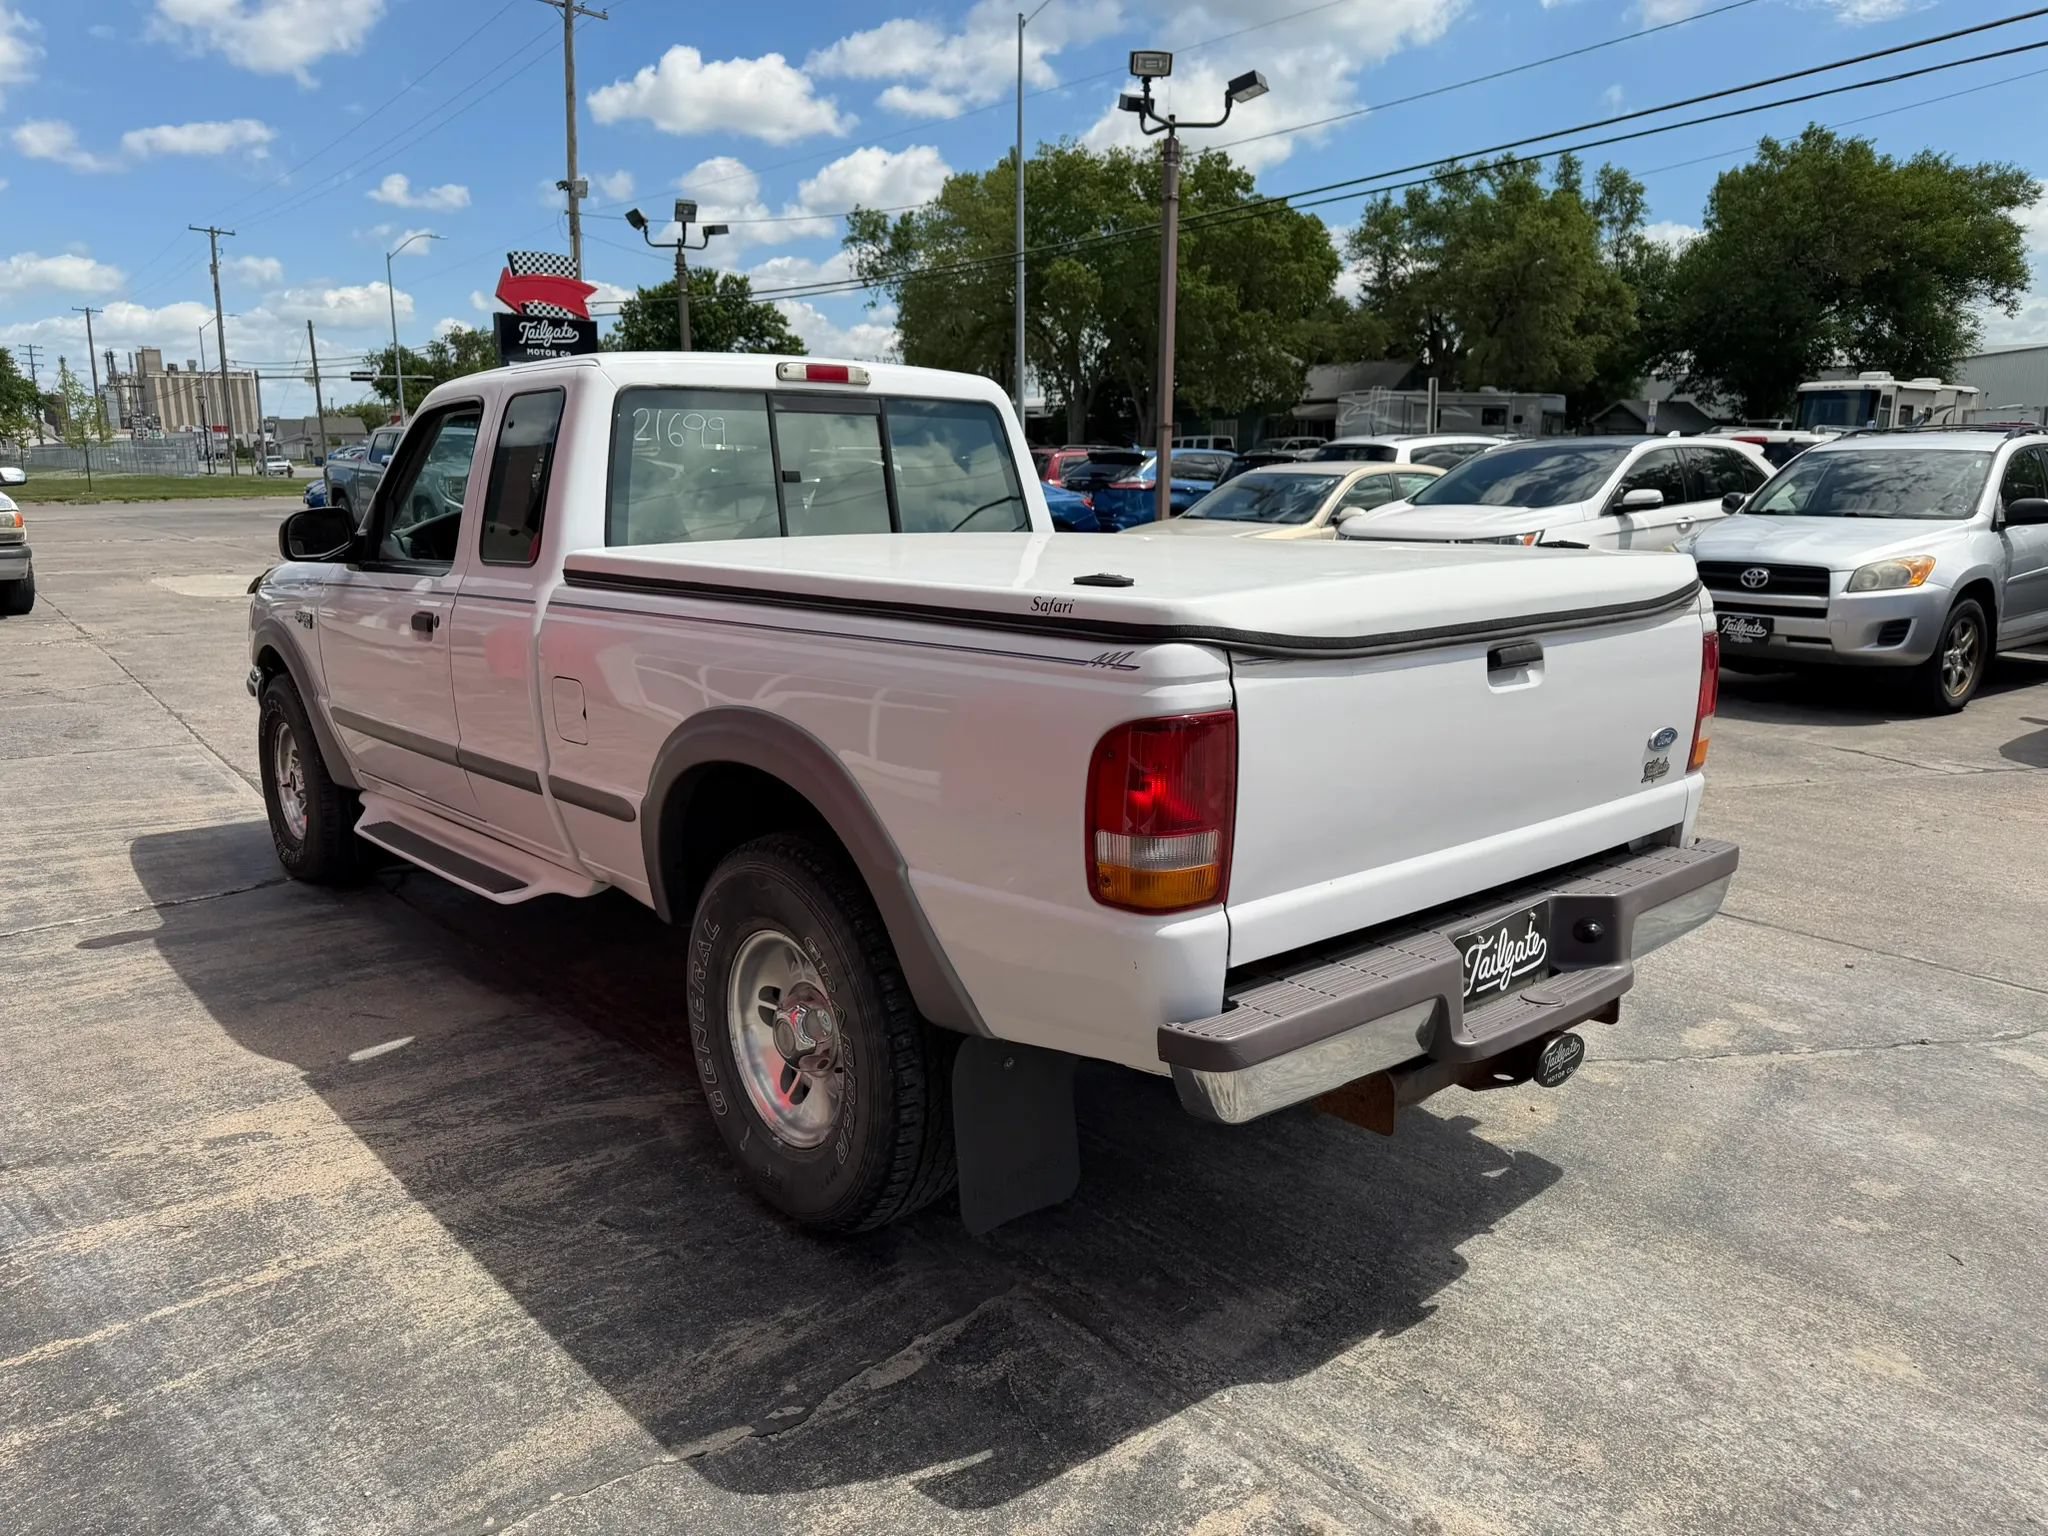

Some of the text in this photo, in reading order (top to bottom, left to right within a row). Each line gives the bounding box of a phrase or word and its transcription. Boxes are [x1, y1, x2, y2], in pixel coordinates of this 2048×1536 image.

[519, 320, 579, 347] Tailgate
[527, 348, 557, 357] MOTOR
[633, 408, 726, 448] 21699
[1030, 596, 1075, 616] Safari
[1720, 617, 1767, 637] Tailgate
[1464, 921, 1547, 997] Tailgate
[691, 919, 729, 1116] GENERAL
[1543, 1037, 1581, 1077] Tailgate
[1546, 1070, 1565, 1085] MOTOR
